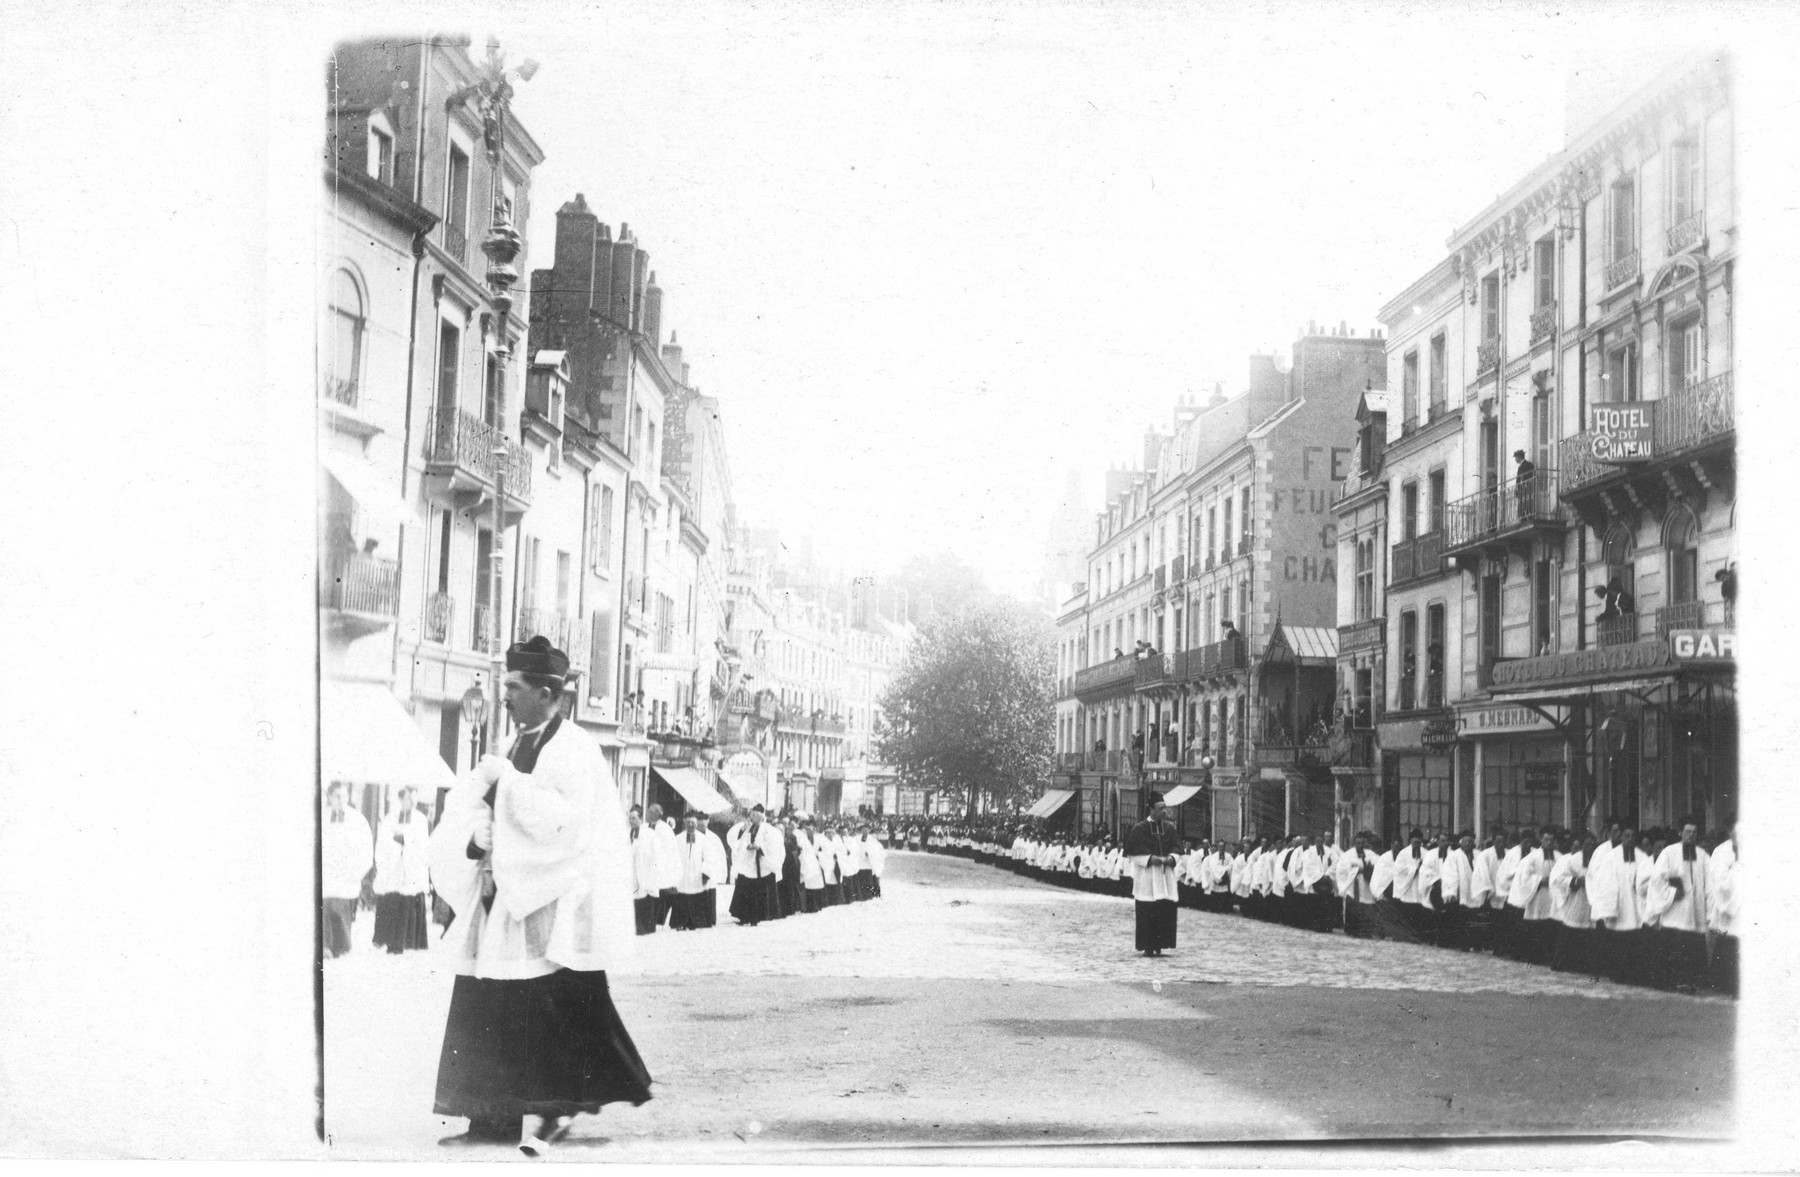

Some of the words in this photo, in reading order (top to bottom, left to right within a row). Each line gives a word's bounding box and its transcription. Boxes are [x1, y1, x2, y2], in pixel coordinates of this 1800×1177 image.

[1591, 408, 1650, 438] HOTEL
[1619, 430, 1638, 440] DU
[1592, 435, 1651, 460] CHATEAU
[1303, 446, 1351, 481] FE
[1284, 556, 1337, 583] CHA
[1422, 734, 1456, 744] MICHELIN
